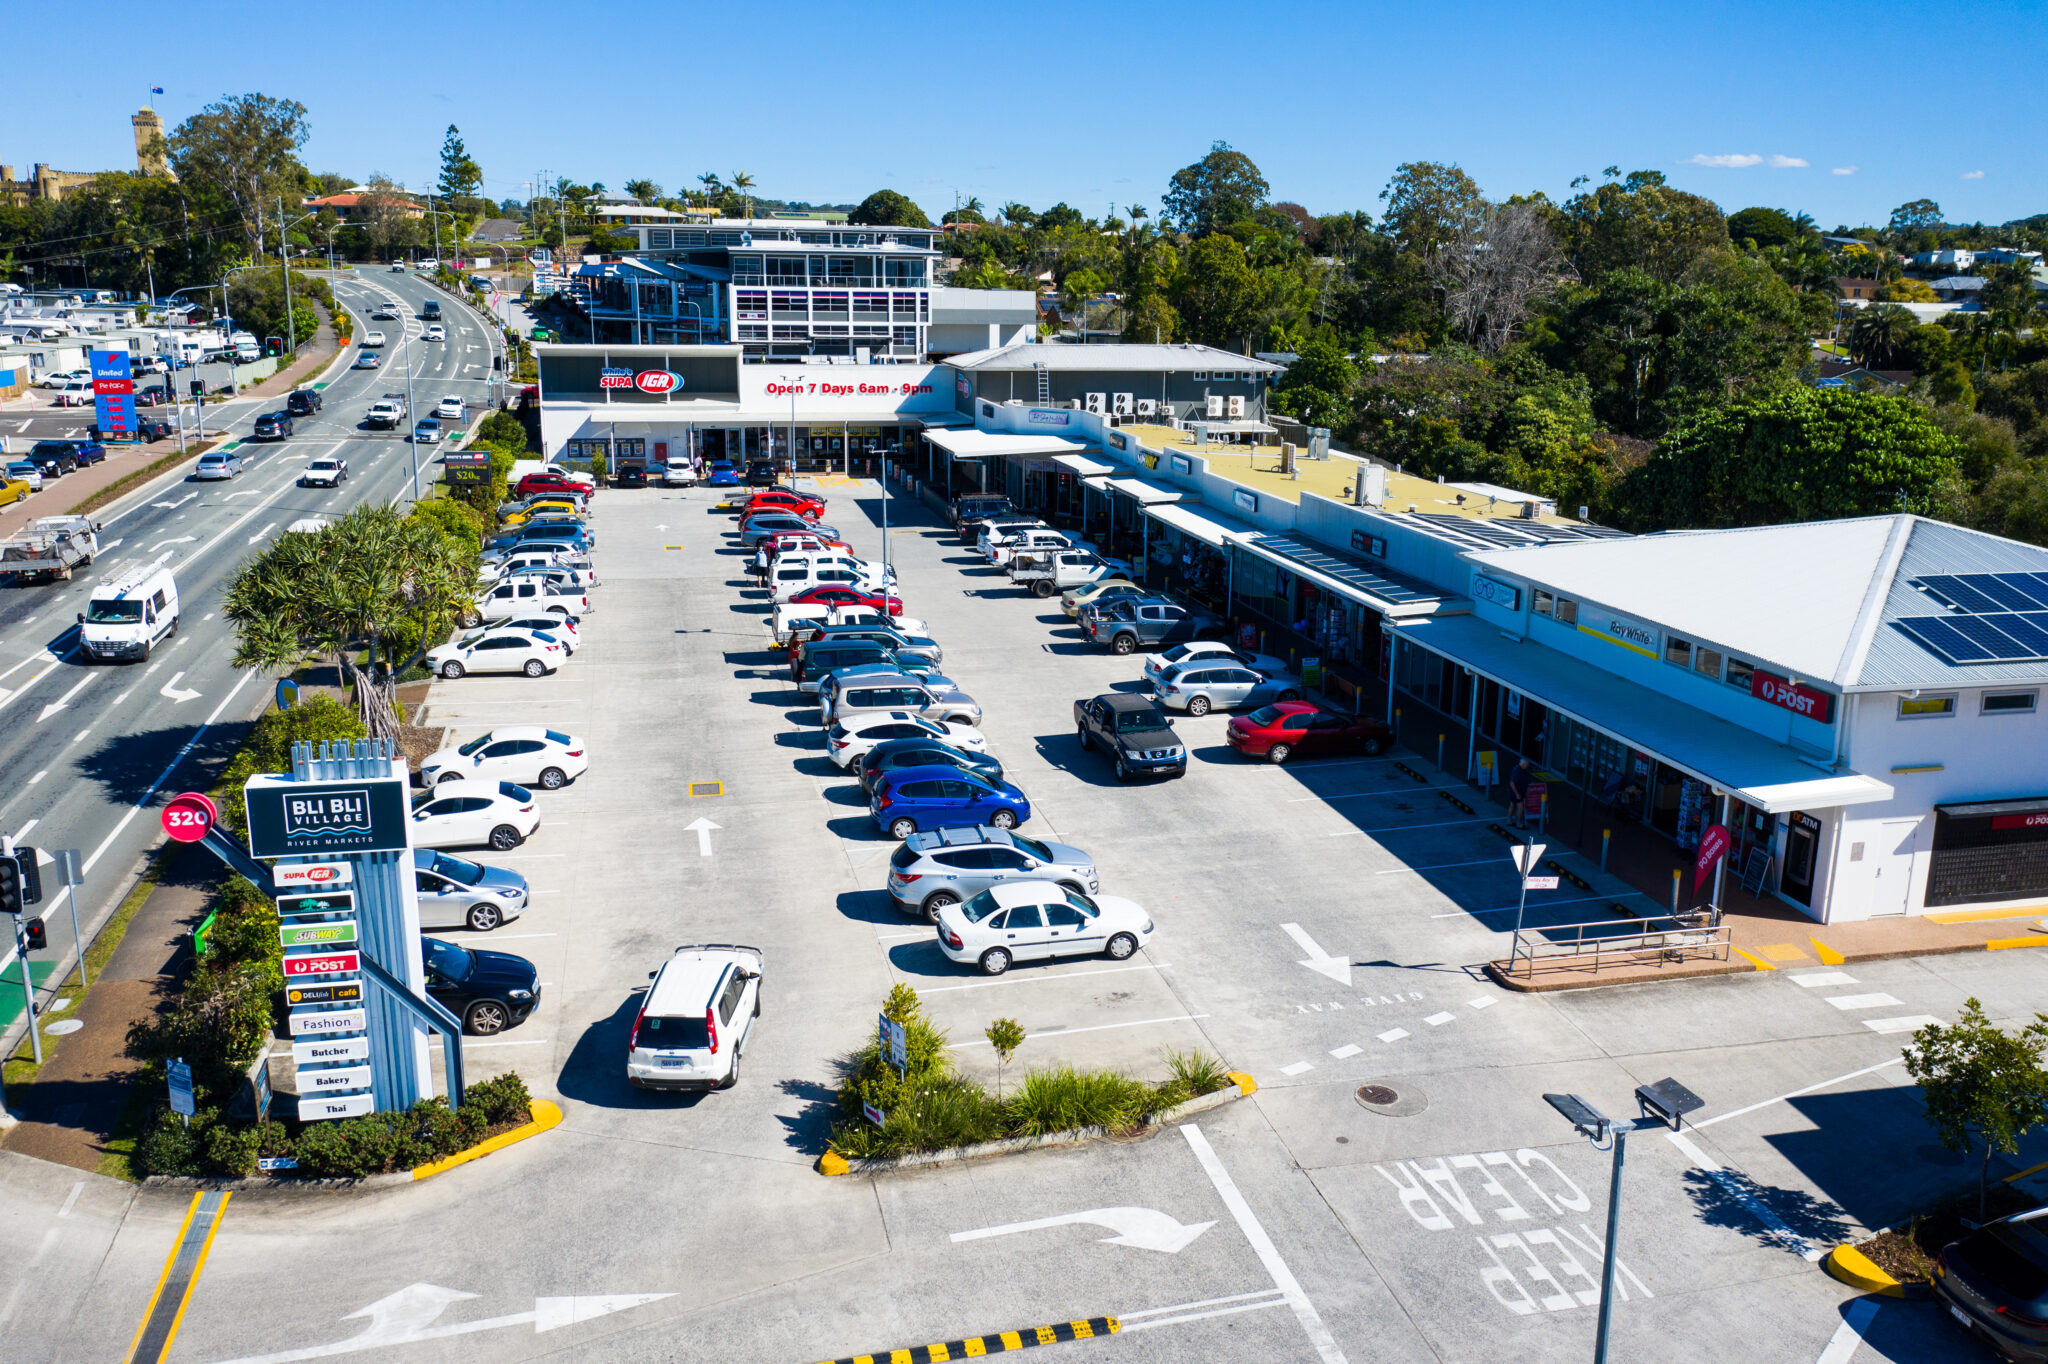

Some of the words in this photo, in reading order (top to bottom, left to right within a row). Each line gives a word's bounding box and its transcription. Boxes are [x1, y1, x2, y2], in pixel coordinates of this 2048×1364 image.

[600, 377, 633, 388] SUPA
[641, 374, 669, 388] IGA
[767, 383, 804, 395] Open
[808, 383, 816, 393] 7
[822, 383, 854, 395] Days
[859, 383, 889, 393] 6am
[902, 383, 932, 395] 9pm
[1610, 620, 1626, 638] Ray
[1627, 626, 1650, 645] White
[1776, 688, 1814, 713] POST
[292, 800, 324, 816] BLI
[330, 798, 361, 814] BLI
[168, 810, 208, 826] 320
[294, 814, 363, 825] VILLAGE
[325, 836, 374, 845] MARKETS
[1699, 856, 1708, 869] PO
[1706, 838, 1723, 859] Boxes
[284, 872, 305, 880] SUPA
[310, 870, 332, 879] IGA
[294, 928, 343, 942] SUBWAY
[310, 960, 346, 972] POST
[338, 988, 357, 997] café
[1360, 992, 1424, 1006] GIVE
[1296, 1001, 1345, 1014] WAY
[303, 1018, 351, 1030] Fashion
[312, 1047, 349, 1057] Butcher
[316, 1076, 350, 1086] Bakery
[326, 1105, 347, 1113] Thai
[1373, 1148, 1591, 1231] CLEAR
[1476, 1224, 1654, 1315] KEEP
